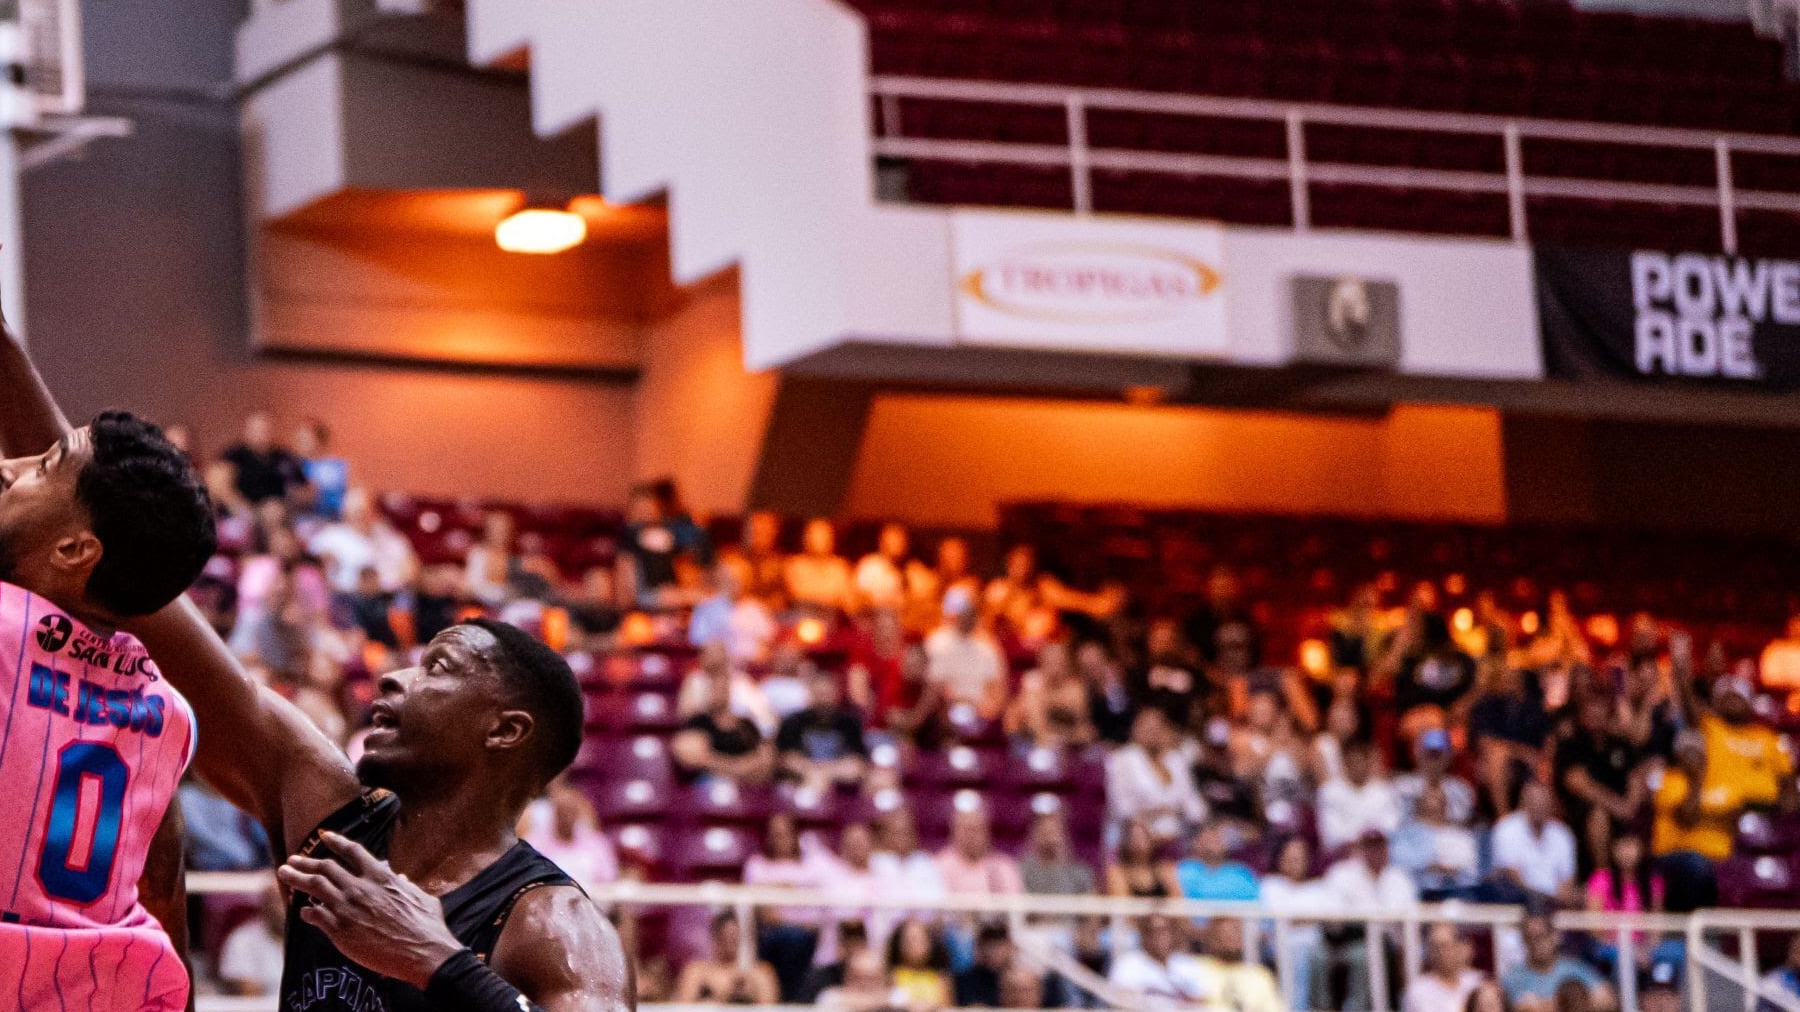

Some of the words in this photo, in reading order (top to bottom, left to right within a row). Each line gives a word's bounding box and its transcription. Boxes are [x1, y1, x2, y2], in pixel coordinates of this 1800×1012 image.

[68, 638, 112, 669] SAN
[27, 661, 71, 717] DE
[38, 738, 130, 906] 0
